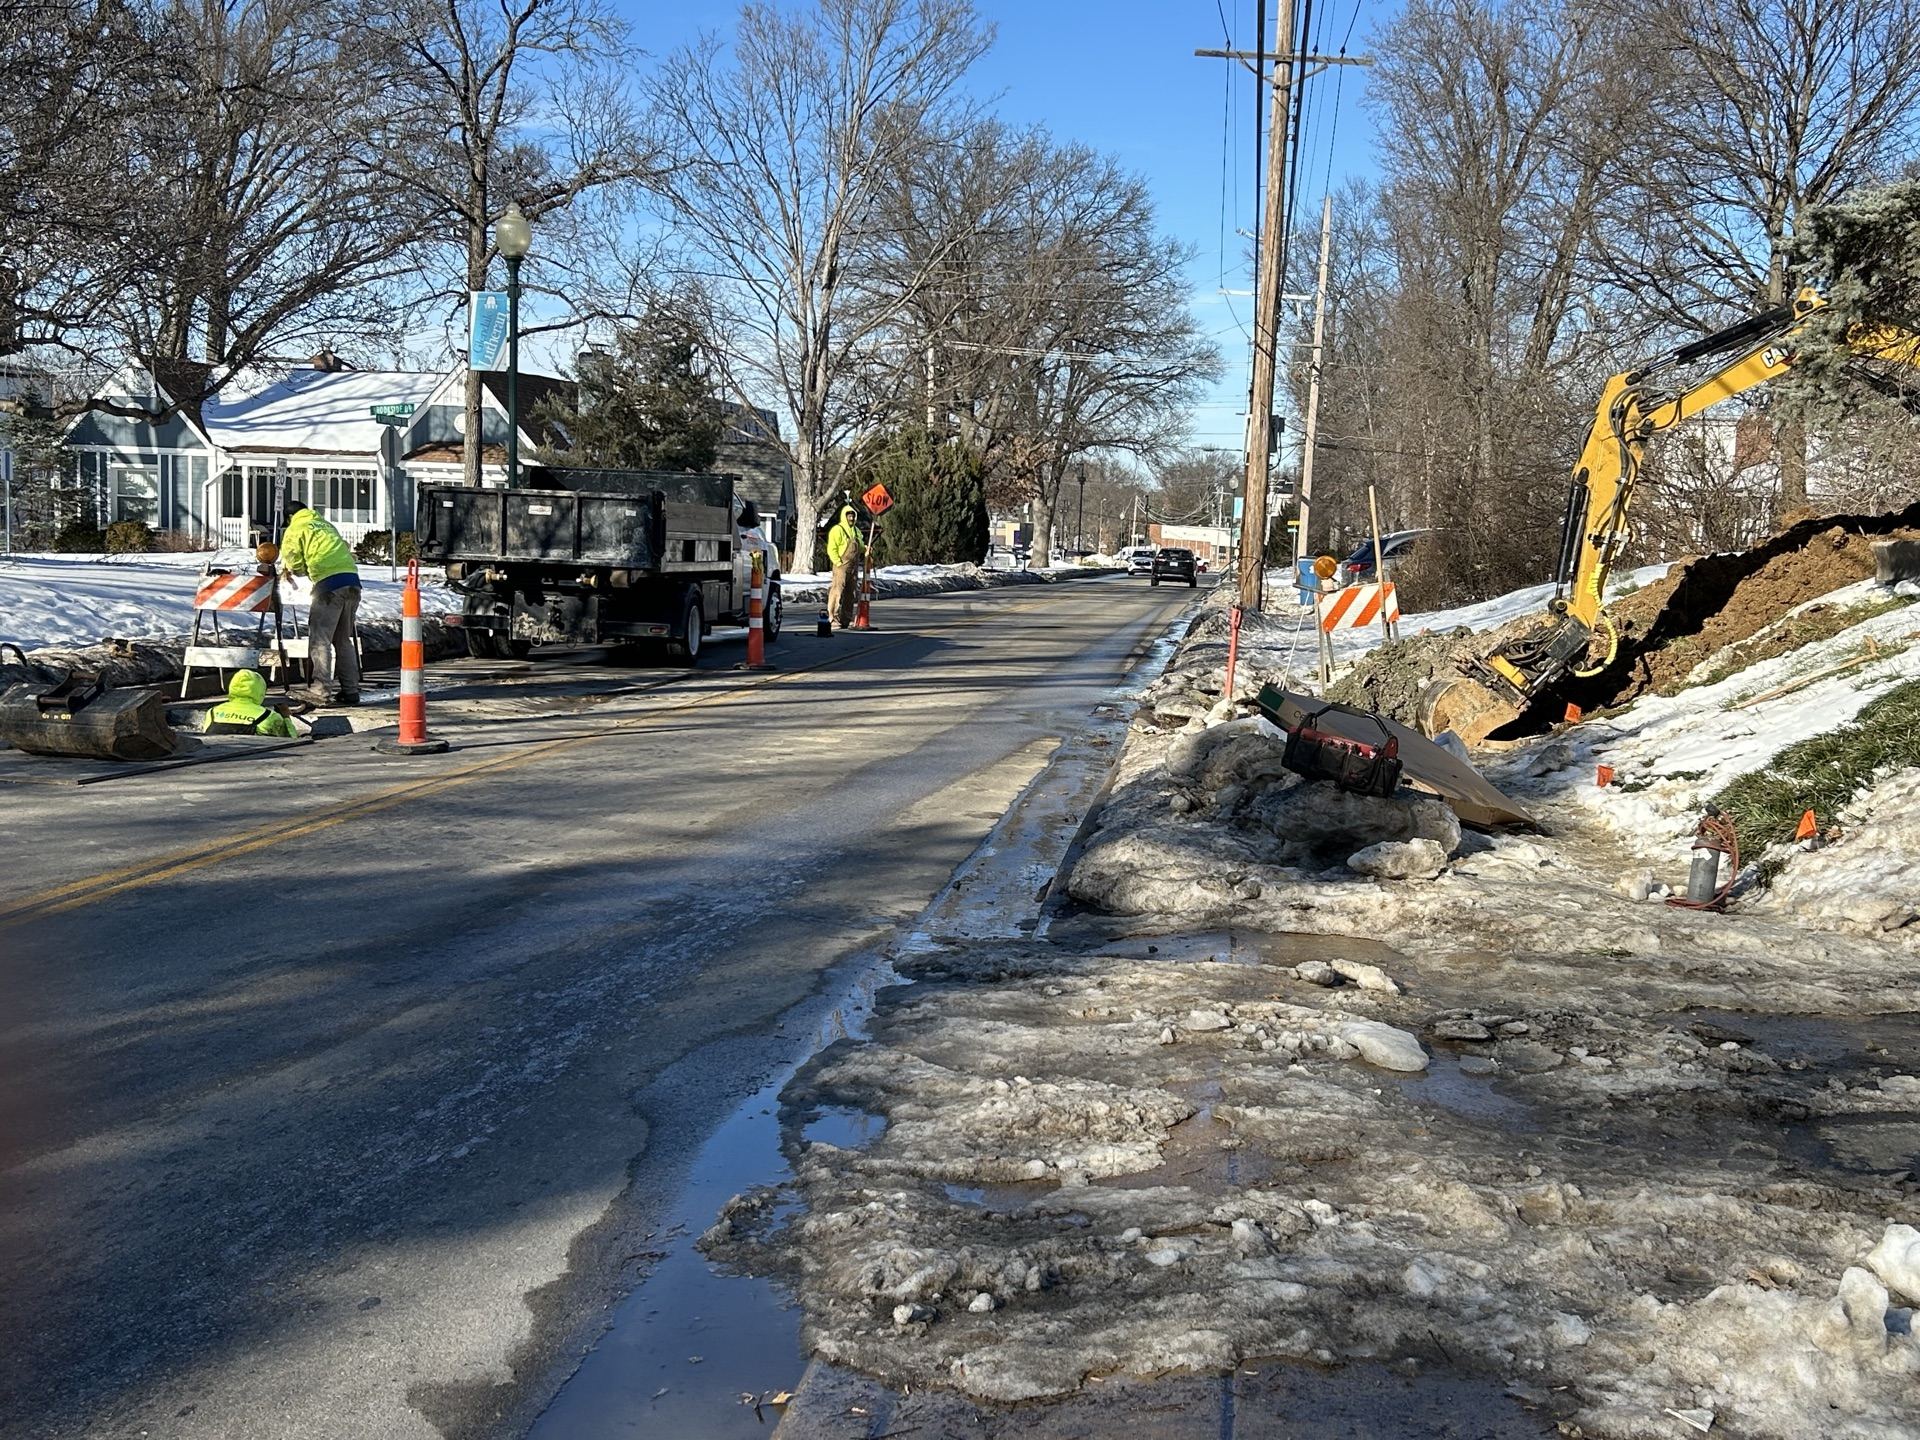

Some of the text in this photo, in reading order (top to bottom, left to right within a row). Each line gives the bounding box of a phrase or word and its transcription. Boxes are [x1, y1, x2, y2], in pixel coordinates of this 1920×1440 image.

[478, 312, 507, 367] Lutheran
[373, 404, 404, 415] ROOKSIDE
[276, 474, 285, 486] 20
[865, 492, 890, 507] SLOW
